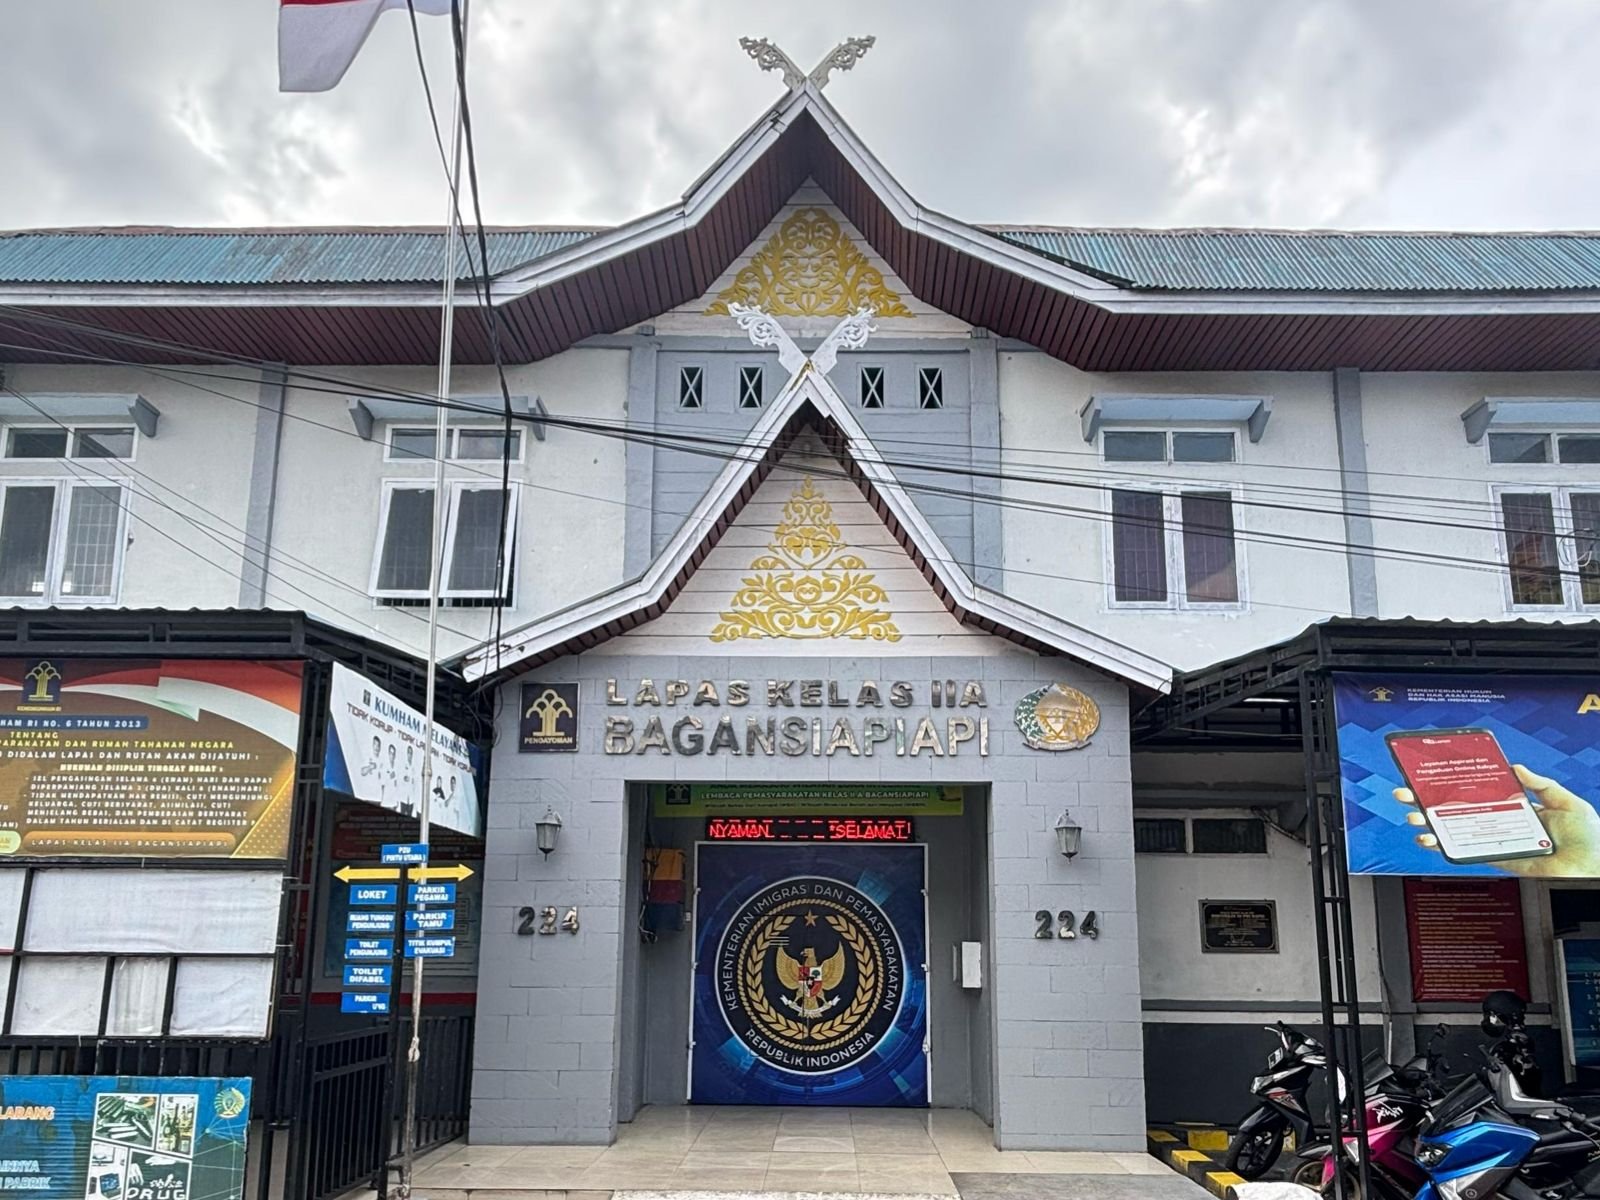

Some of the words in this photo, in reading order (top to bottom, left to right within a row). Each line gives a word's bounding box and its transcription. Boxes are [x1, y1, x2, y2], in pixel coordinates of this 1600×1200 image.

[606, 678, 750, 707] LAPAS
[767, 679, 914, 708] KELAS
[931, 679, 988, 708] IIA
[374, 696, 421, 734] KUMHAM
[43, 720, 60, 728] NO.
[77, 720, 110, 728] TAHUN
[114, 720, 141, 728] 2013
[10, 731, 59, 739] TENTANG
[604, 714, 989, 758] BAGANSIAPIAPI
[65, 740, 87, 748] DAN
[134, 741, 186, 749] TAHANAN
[190, 741, 234, 749] NEGARA
[524, 736, 573, 745] PENGAYOMAN
[61, 751, 94, 759] LAPAS
[99, 751, 121, 759] DAN
[126, 752, 161, 760] RUTAN
[166, 752, 196, 760] AKAN
[200, 752, 251, 760] DIJATUHI
[60, 763, 103, 772] HUKUMAN
[105, 764, 145, 772] DISIPLIN
[147, 765, 187, 773] TINGKAT
[188, 765, 217, 773] BERAT
[865, 791, 929, 799] BAGANSIAPIAPI
[709, 824, 770, 838] NYAMAN
[137, 840, 229, 848] BAGANSIAPIAPI
[357, 889, 388, 900] LOKET
[417, 886, 446, 894] PARKIR
[414, 893, 449, 902] PEGAWAI
[412, 912, 447, 921] PARKIR
[517, 905, 580, 936] 224
[417, 920, 444, 928] TAMU
[1034, 909, 1099, 940] 224
[722, 911, 755, 1011] KEMENTERIAN
[814, 884, 844, 900] DAN
[845, 894, 899, 1011] PEMASYARAKATAN
[352, 967, 384, 976] TOILET
[349, 975, 385, 984] DIFABEL
[354, 994, 377, 1003] PARKIR
[745, 1027, 804, 1067] REPUBLIK
[806, 1031, 876, 1068] INDONESIA
[3, 1176, 52, 1190] PABRIK
[126, 1186, 188, 1200] DRUG
